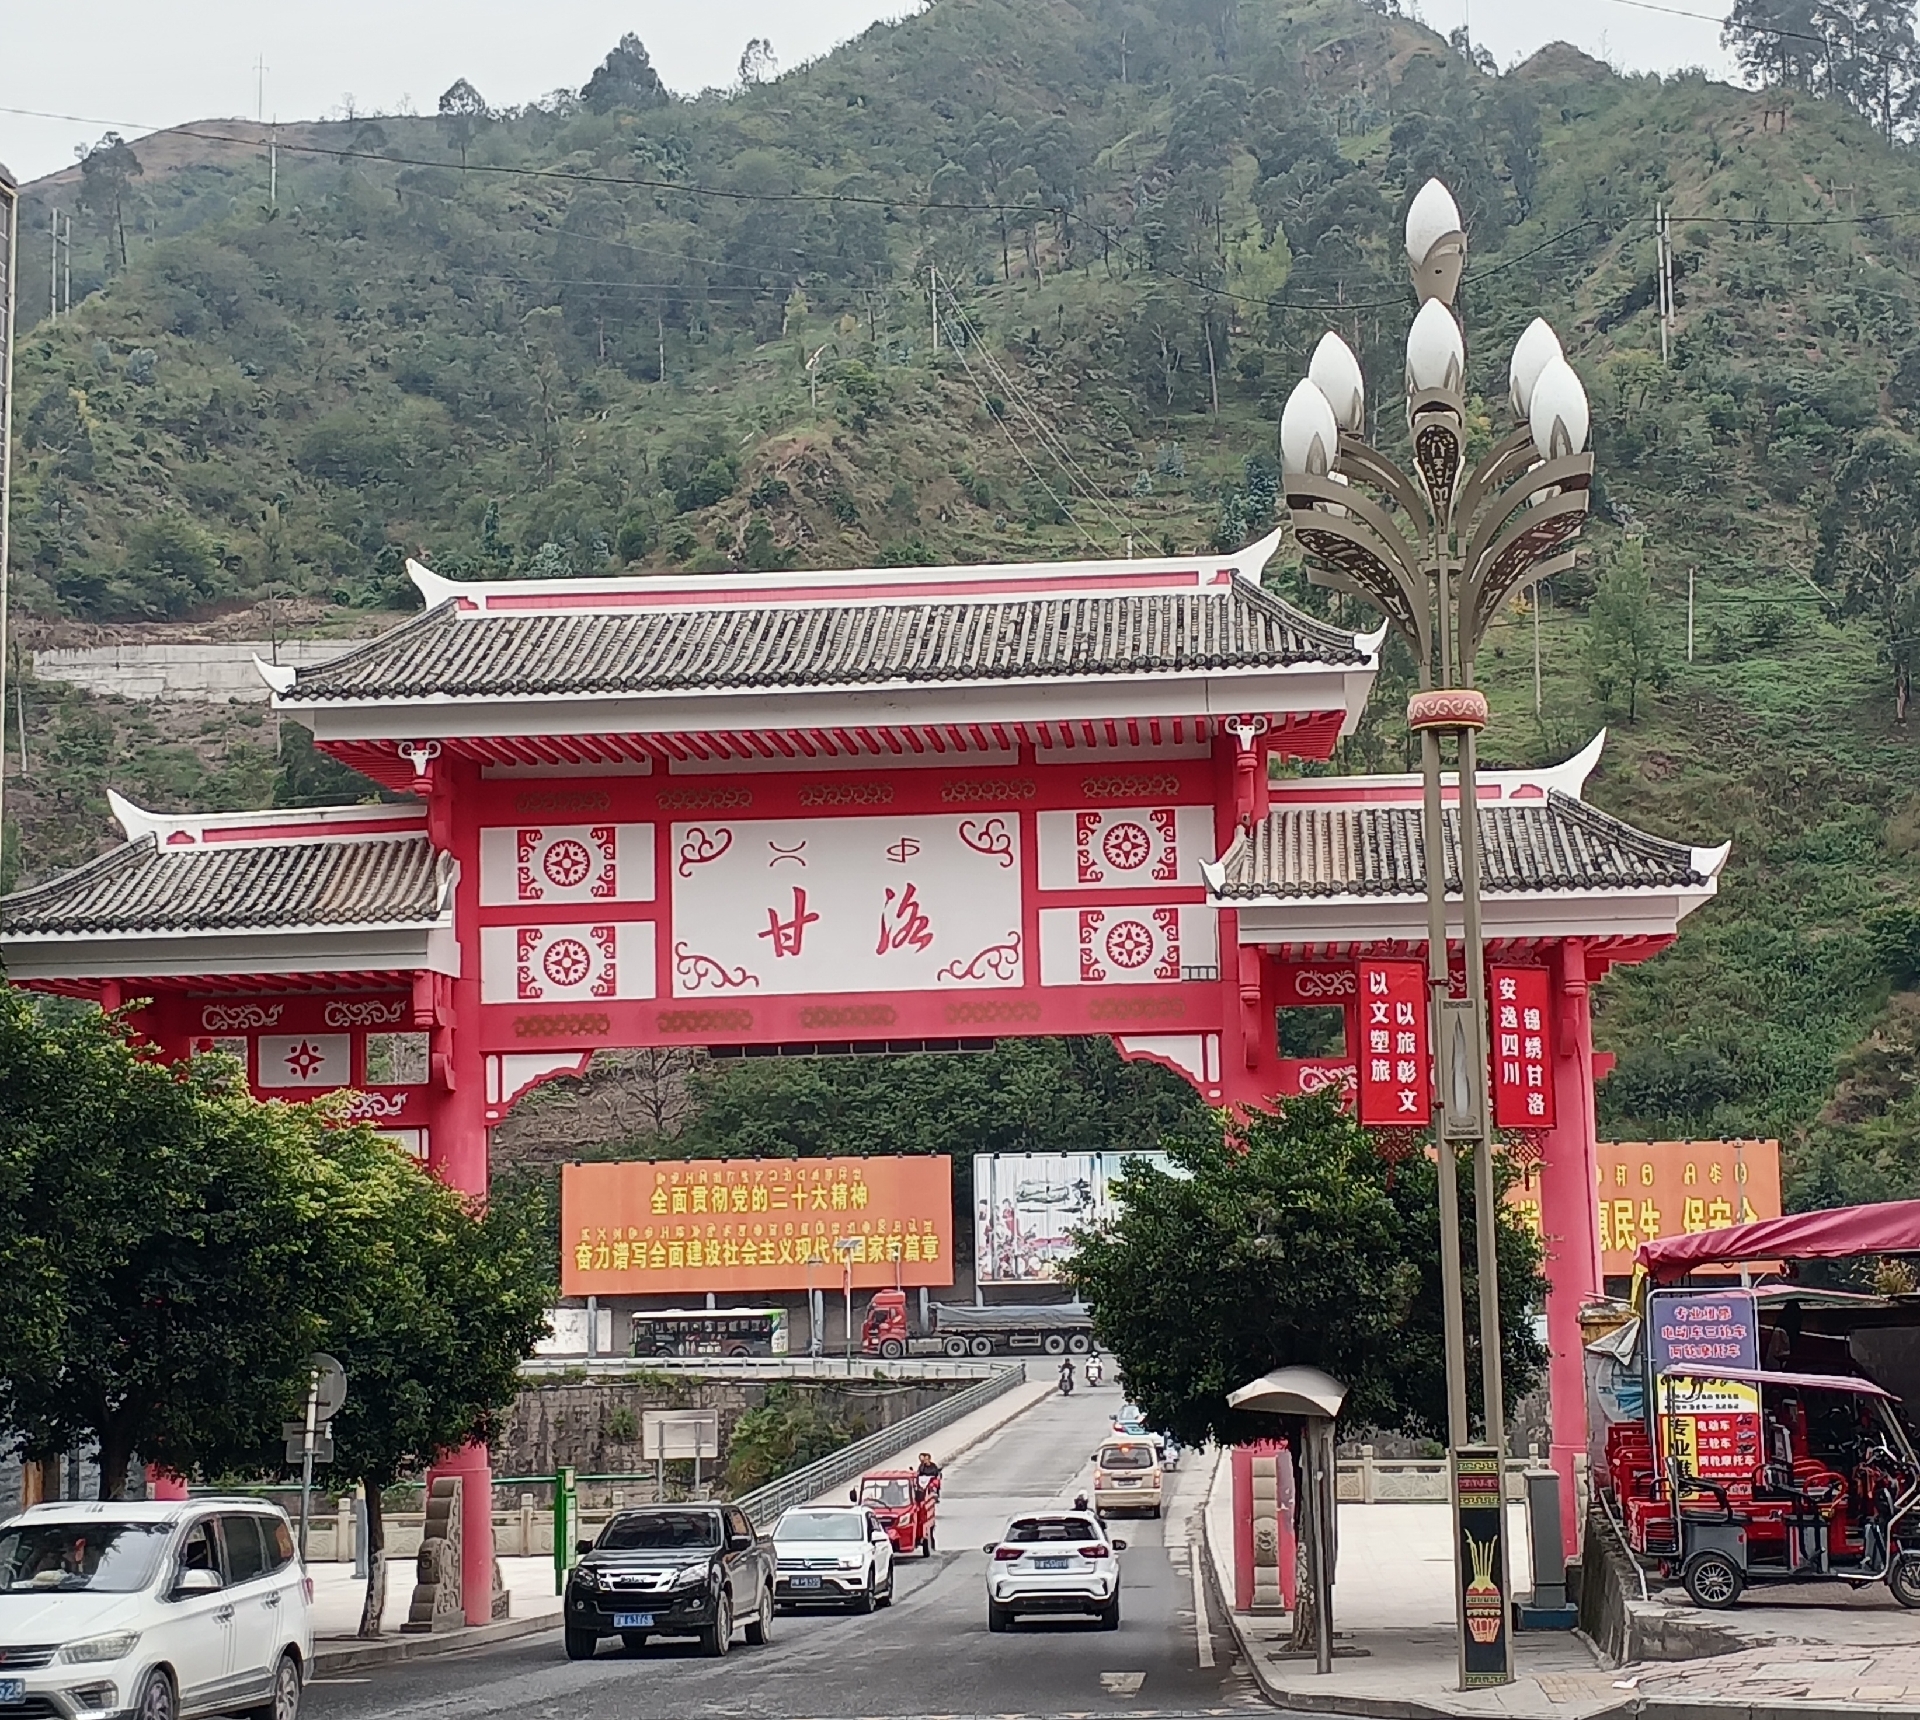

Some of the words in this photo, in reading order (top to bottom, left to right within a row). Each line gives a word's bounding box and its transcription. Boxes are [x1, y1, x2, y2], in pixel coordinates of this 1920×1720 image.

[758, 883, 933, 957] 甘洛
[1369, 971, 1391, 1082] 以文塑旅
[1396, 1002, 1417, 1112] 以旅彰文
[1499, 977, 1520, 1086] 安逸四川
[1523, 1008, 1545, 1116] 锦绣甘洛
[651, 1181, 868, 1215] 全面贯彻党的二十大精神
[575, 1234, 939, 1271] 奋力谱写全面建设社会主义现代化国家新篇章
